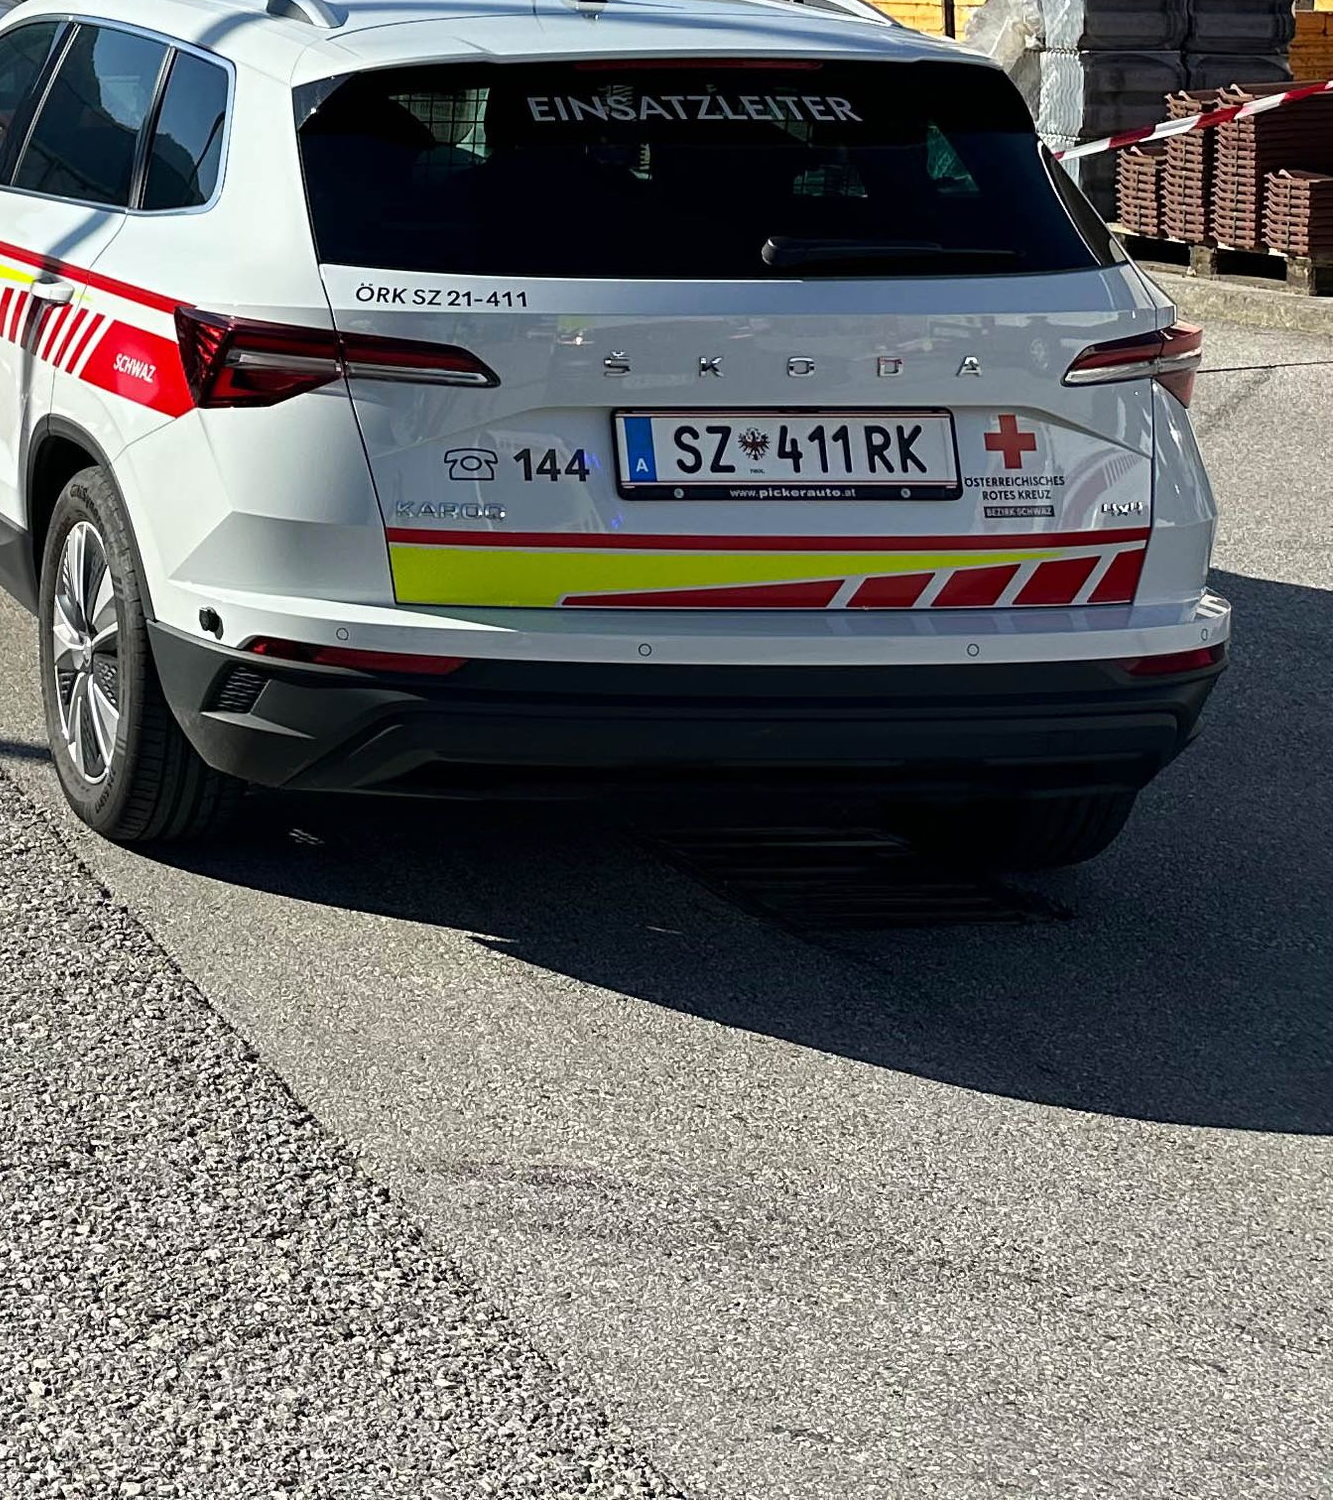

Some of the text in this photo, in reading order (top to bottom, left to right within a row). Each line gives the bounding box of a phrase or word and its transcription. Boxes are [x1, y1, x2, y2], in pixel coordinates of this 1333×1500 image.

[527, 95, 864, 123] EINSATZLEITER
[355, 283, 408, 305] ÖRK
[446, 289, 528, 308] 21-411
[113, 353, 157, 384] SCHWAZ
[673, 424, 737, 474] SZ
[512, 448, 591, 482] 144
[635, 457, 650, 473] A
[964, 475, 1066, 488] ÖSTERREICHISCHES
[729, 487, 857, 500] www.pickerauto.at
[983, 489, 1052, 501] ROTES KREUZ
[395, 500, 508, 522] KAROQ
[986, 506, 1053, 517] BEZIRK SCHWAZ
